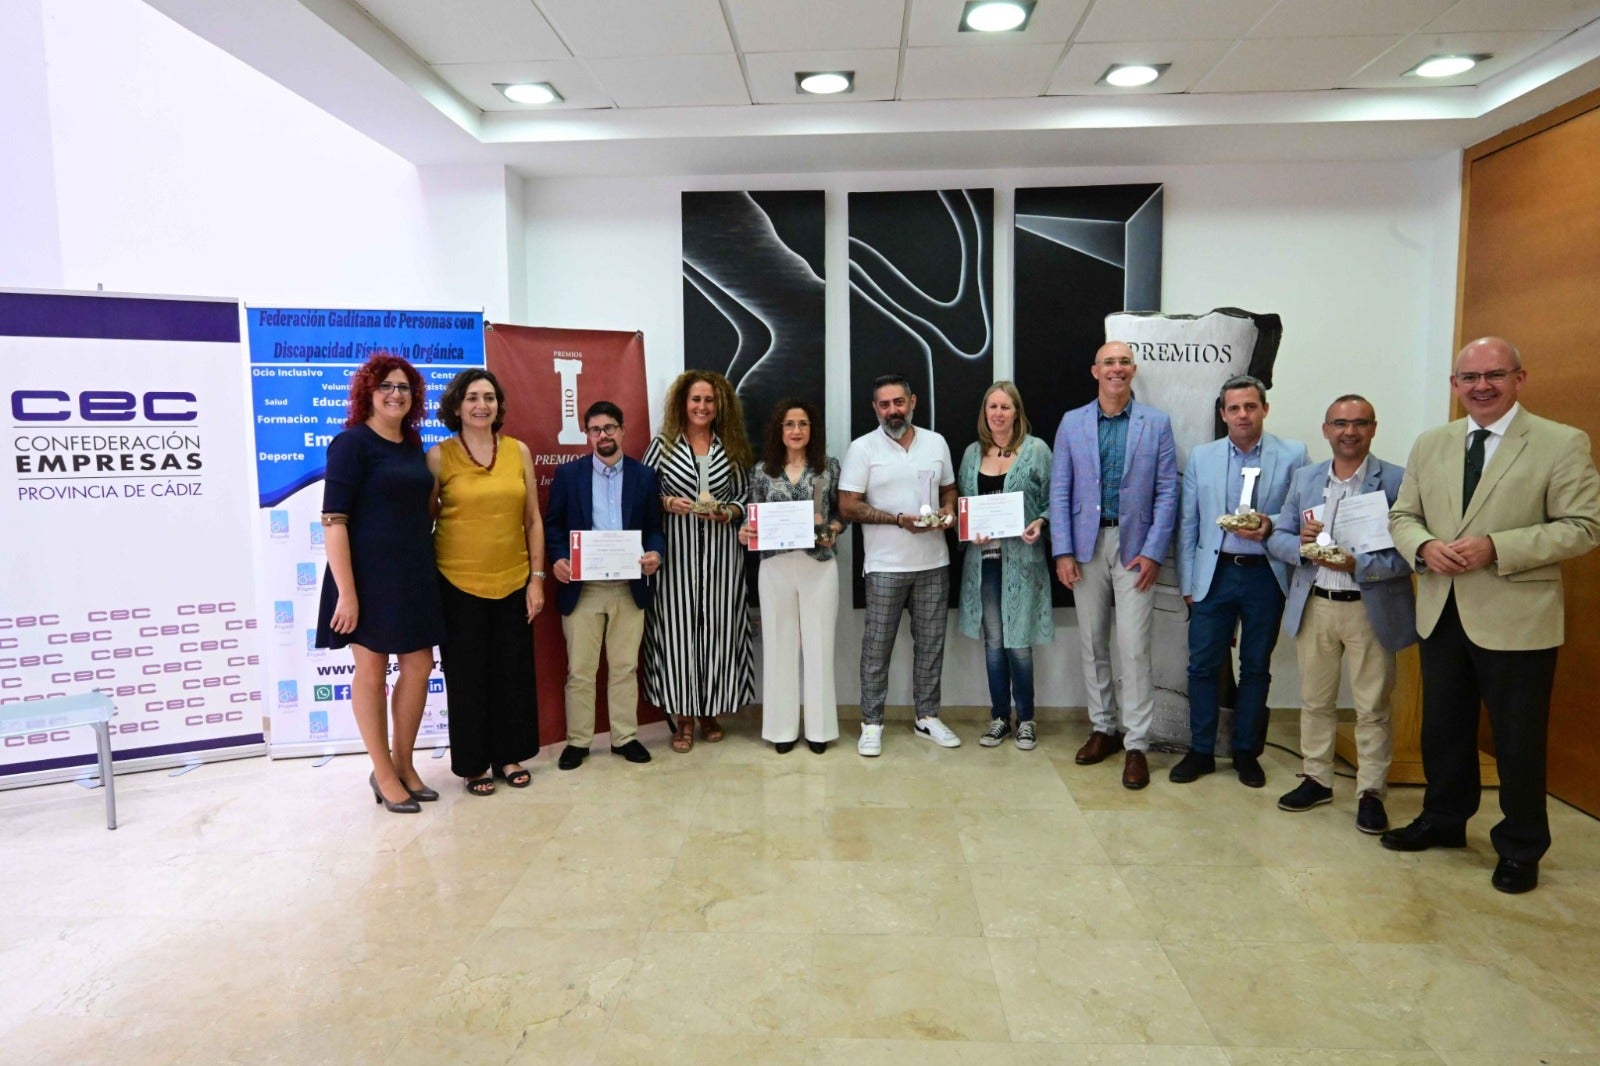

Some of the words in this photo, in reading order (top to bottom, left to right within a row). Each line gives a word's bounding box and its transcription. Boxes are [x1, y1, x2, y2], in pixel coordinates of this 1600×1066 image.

[259, 310, 326, 328] Federación
[328, 311, 380, 328] Gaditana
[383, 313, 395, 328] de
[398, 313, 451, 328] Personas
[454, 316, 475, 330] con
[274, 341, 353, 362] Discapacidad
[412, 342, 464, 363] Orgánica
[1127, 342, 1232, 364] PREMIOS
[252, 368, 276, 377] Ocio
[278, 368, 323, 377] Inclusivo
[343, 369, 358, 377] Ce
[11, 390, 198, 421] cec
[264, 398, 288, 406] Salud
[565, 388, 574, 418] uno
[257, 415, 318, 425] Formacion
[14, 431, 200, 452] CONFEDERACIÓN
[16, 452, 203, 473] EMPRESAS
[259, 452, 305, 463] Deporte
[18, 485, 118, 501] PROVINCIA
[124, 484, 146, 498] DE
[151, 480, 203, 497] CÁDIZ
